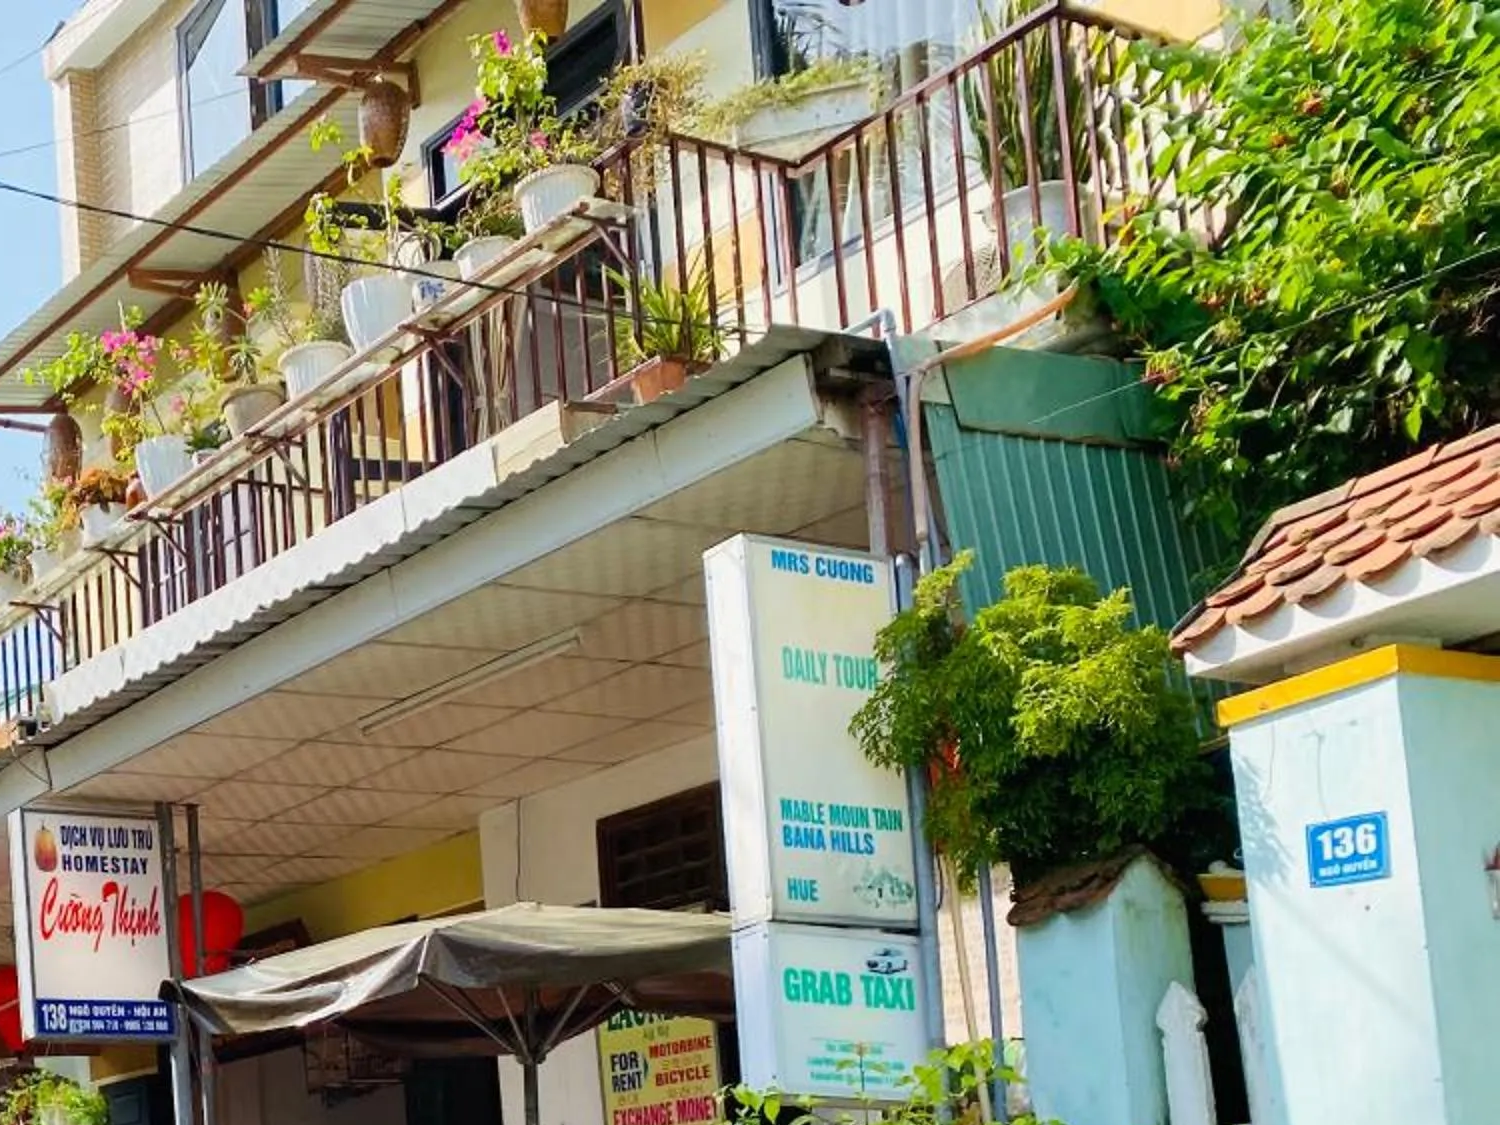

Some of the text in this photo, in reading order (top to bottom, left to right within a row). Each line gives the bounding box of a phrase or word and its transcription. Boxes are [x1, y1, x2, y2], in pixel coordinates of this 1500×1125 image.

[771, 549, 875, 585] MRS CUONG
[782, 645, 827, 686] DAILY
[780, 798, 825, 825] MABLE
[61, 825, 88, 849] DỊCH
[90, 826, 105, 850] VỤ
[783, 824, 875, 855] BANA HILLS
[1316, 823, 1377, 860] 136
[62, 854, 148, 875] HOMESTAY
[788, 878, 819, 902] HUE
[102, 881, 161, 947] Thịnh
[783, 967, 916, 1011] GRAB TAXI
[41, 1003, 67, 1031] 138
[648, 1035, 713, 1058] MOTORBIKE
[610, 1051, 640, 1073] FOR
[655, 1064, 711, 1087] BICYCLE
[611, 1071, 643, 1093] RENT
[677, 1096, 717, 1125] MONEY
